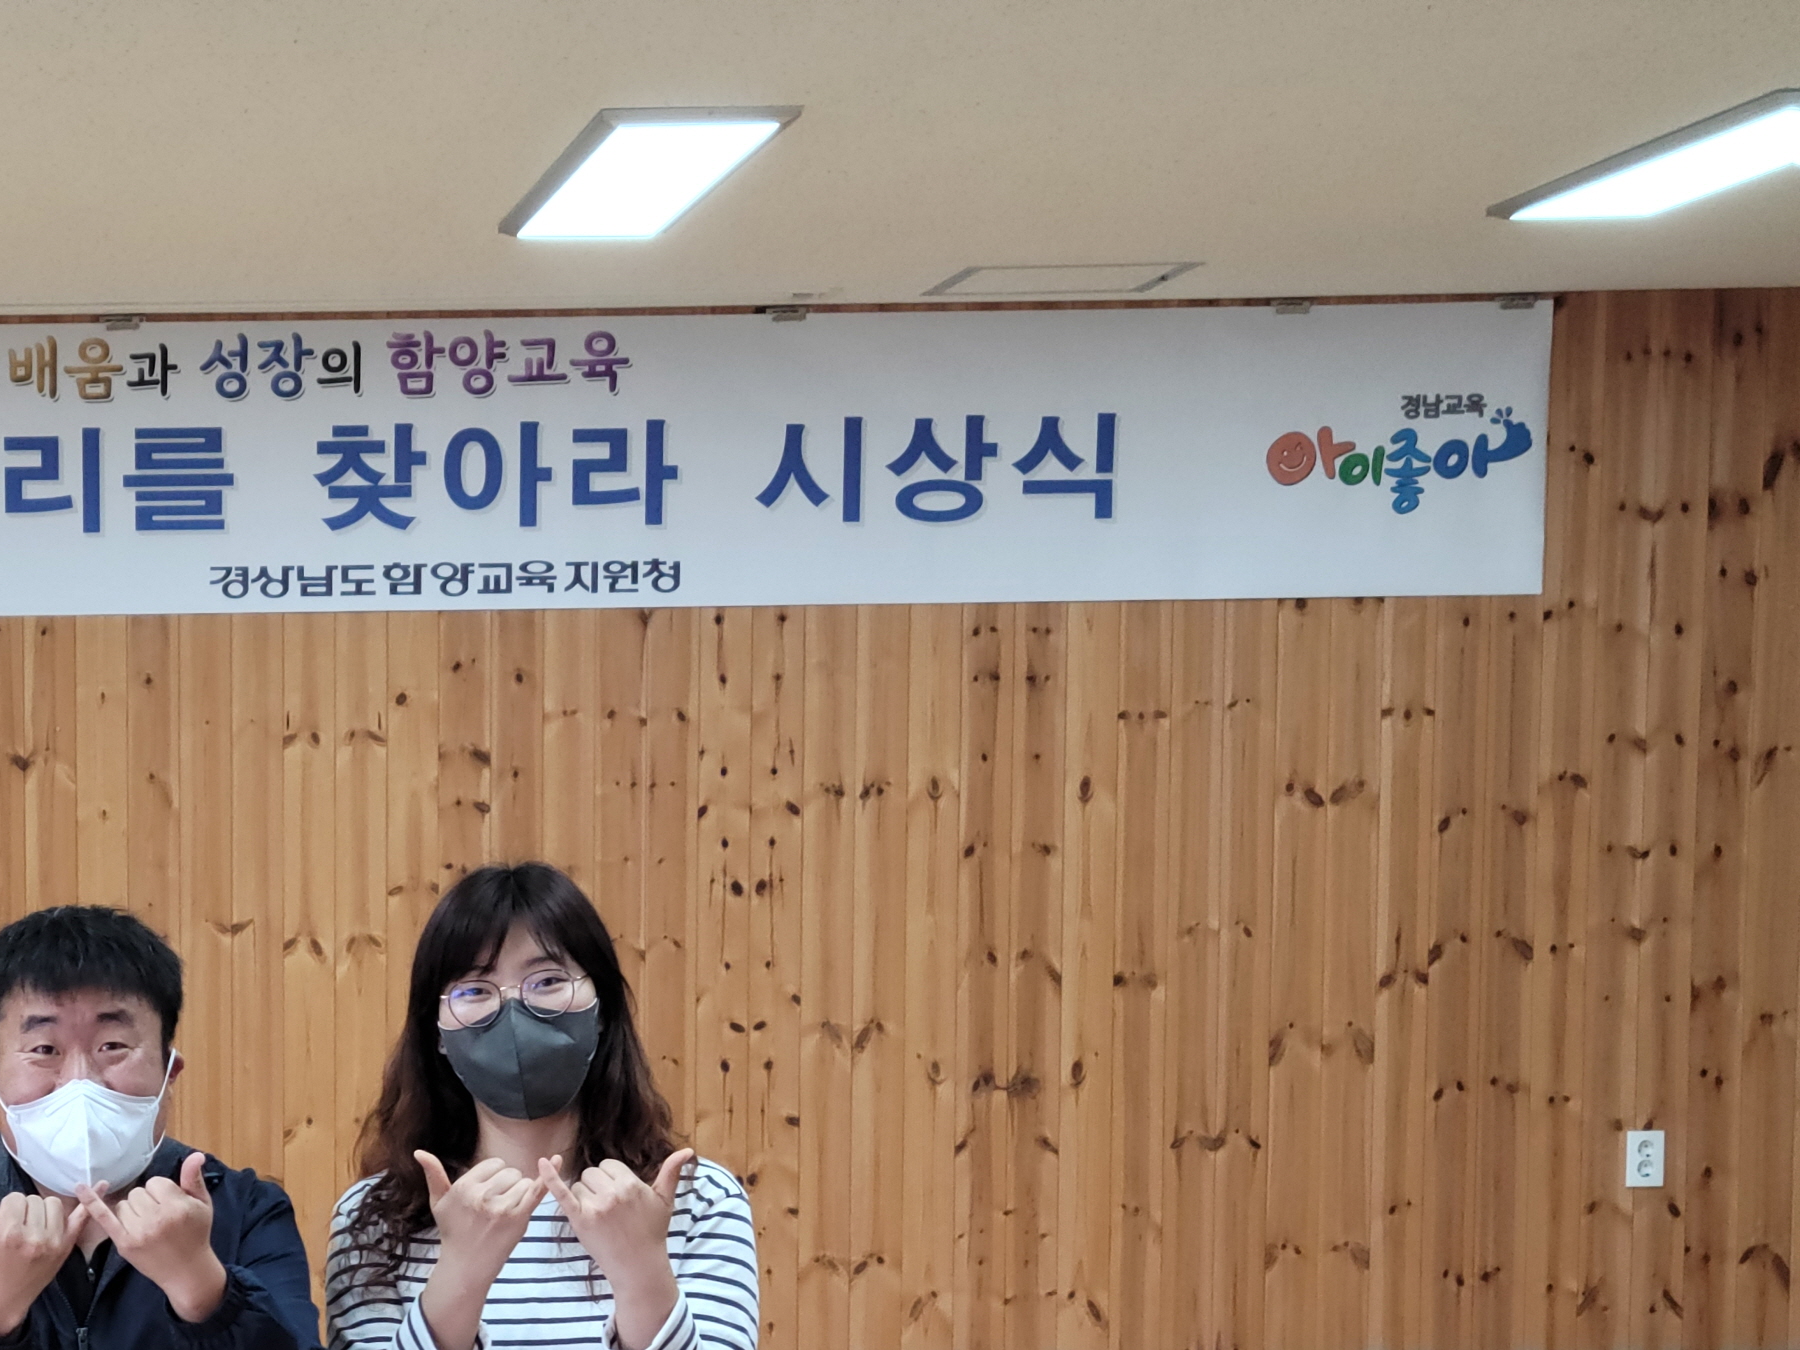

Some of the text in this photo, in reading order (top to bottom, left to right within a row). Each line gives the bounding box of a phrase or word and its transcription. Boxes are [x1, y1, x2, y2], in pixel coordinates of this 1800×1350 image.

[7, 333, 179, 402] 배움과
[198, 333, 363, 400] 성장의
[385, 329, 632, 397] 함양교육
[1400, 393, 1488, 420] 경남교육
[313, 418, 680, 532] 찾아라
[755, 412, 1118, 523] 시상식
[1266, 425, 1532, 515] 아이좋아
